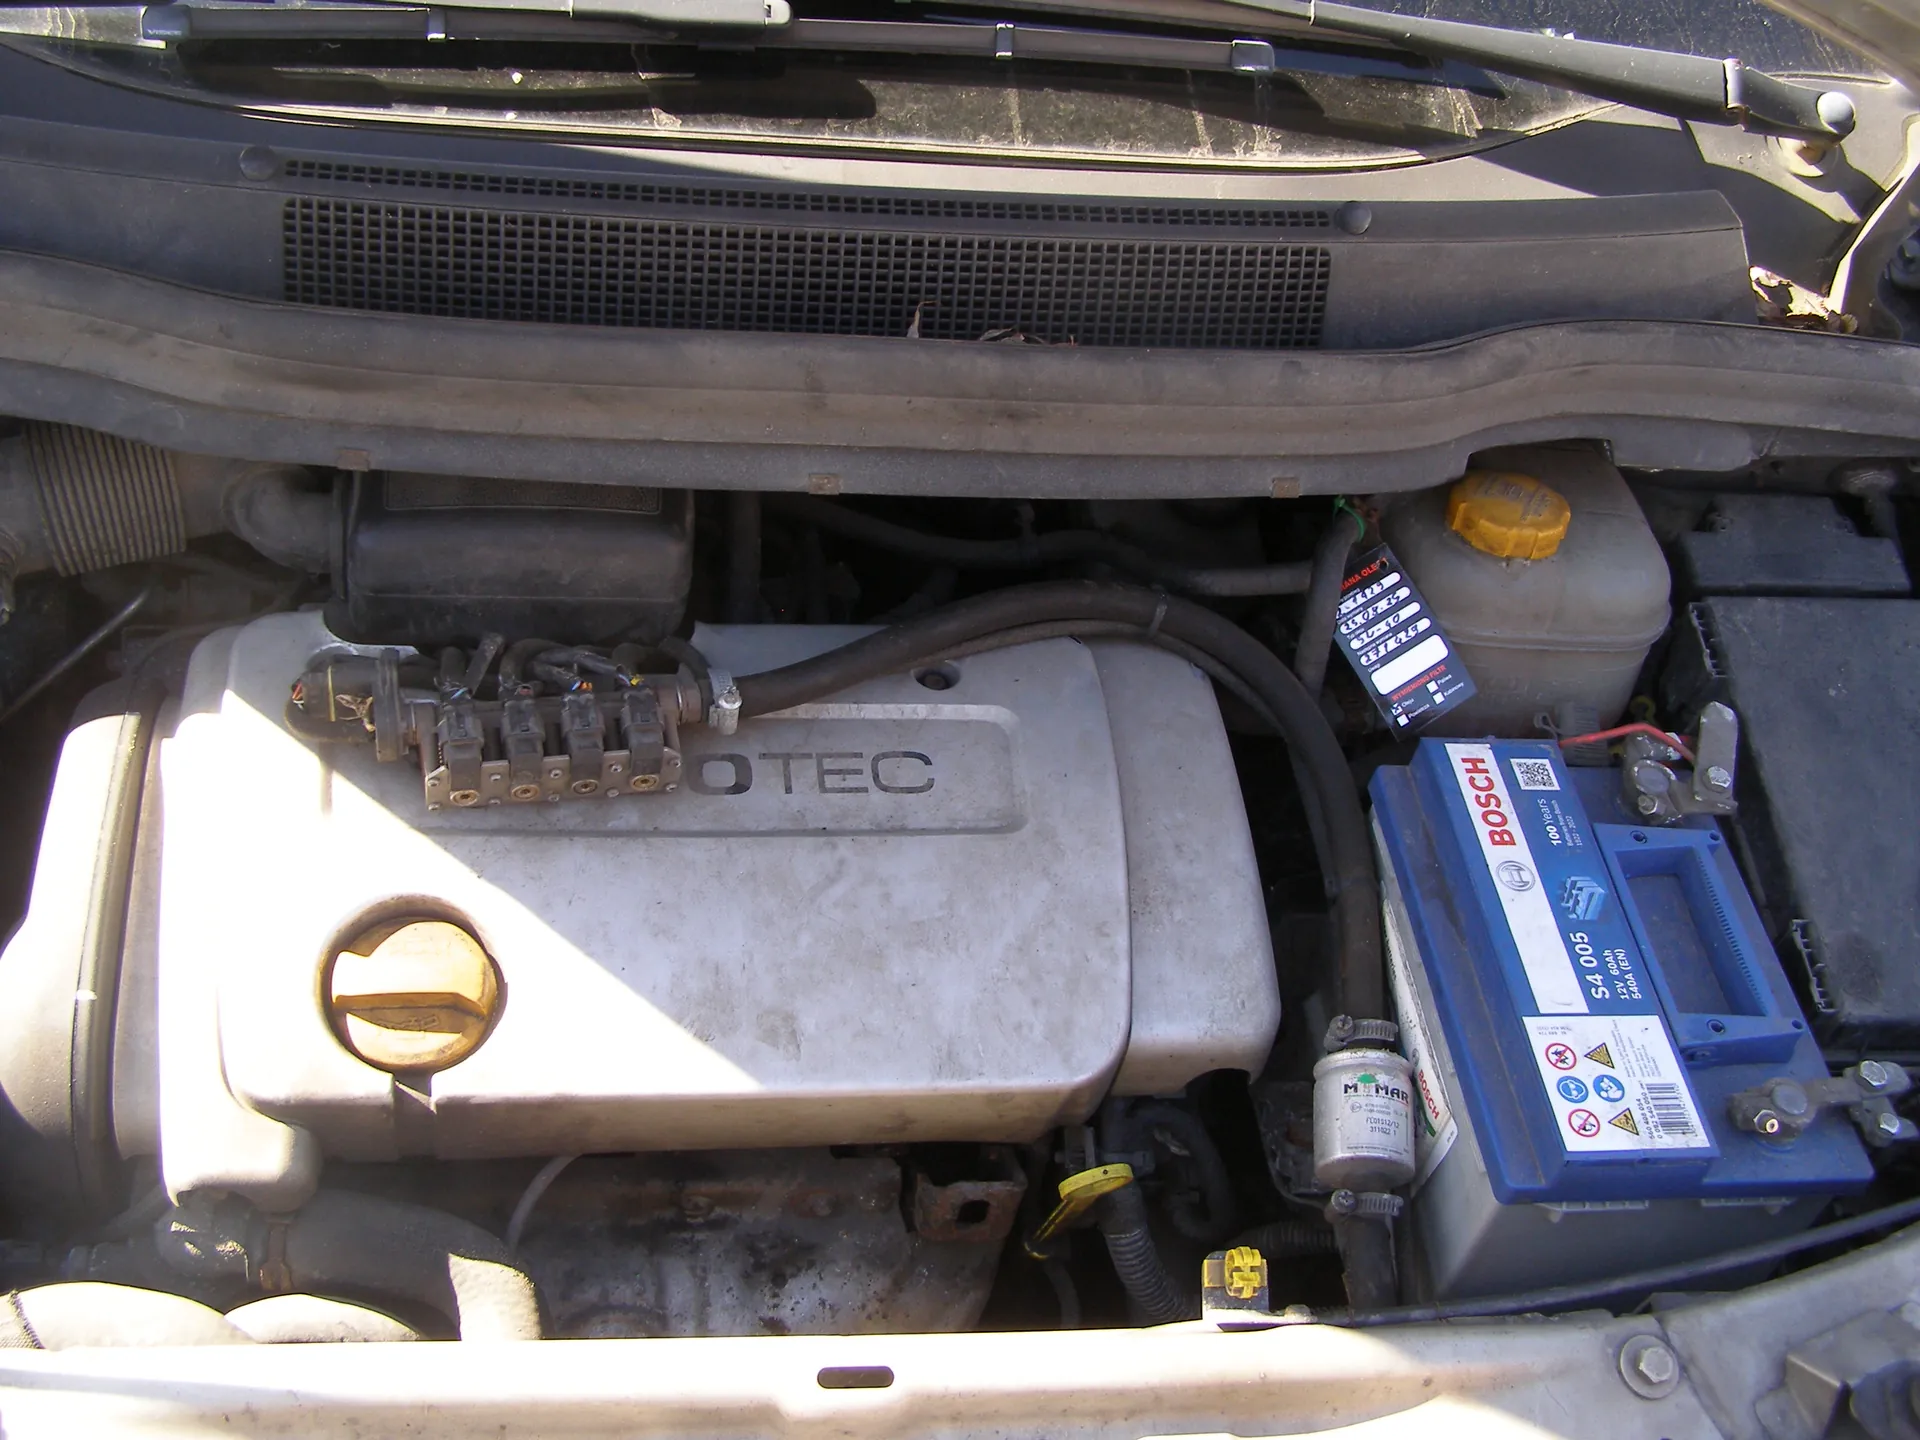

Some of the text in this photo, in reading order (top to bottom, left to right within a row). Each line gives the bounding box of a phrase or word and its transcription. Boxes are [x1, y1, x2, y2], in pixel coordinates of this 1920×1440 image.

[686, 751, 935, 796] OTEC
[1461, 757, 1517, 847] BOSCH
[1537, 798, 1562, 847] 100 Years
[1569, 932, 1610, 999] S4 005
[1603, 949, 1619, 976] 60Ah
[1614, 948, 1632, 971] (EN)
[1614, 980, 1630, 999] 12V
[1624, 972, 1642, 999] 540A
[1418, 1069, 1440, 1120] BOSCH
